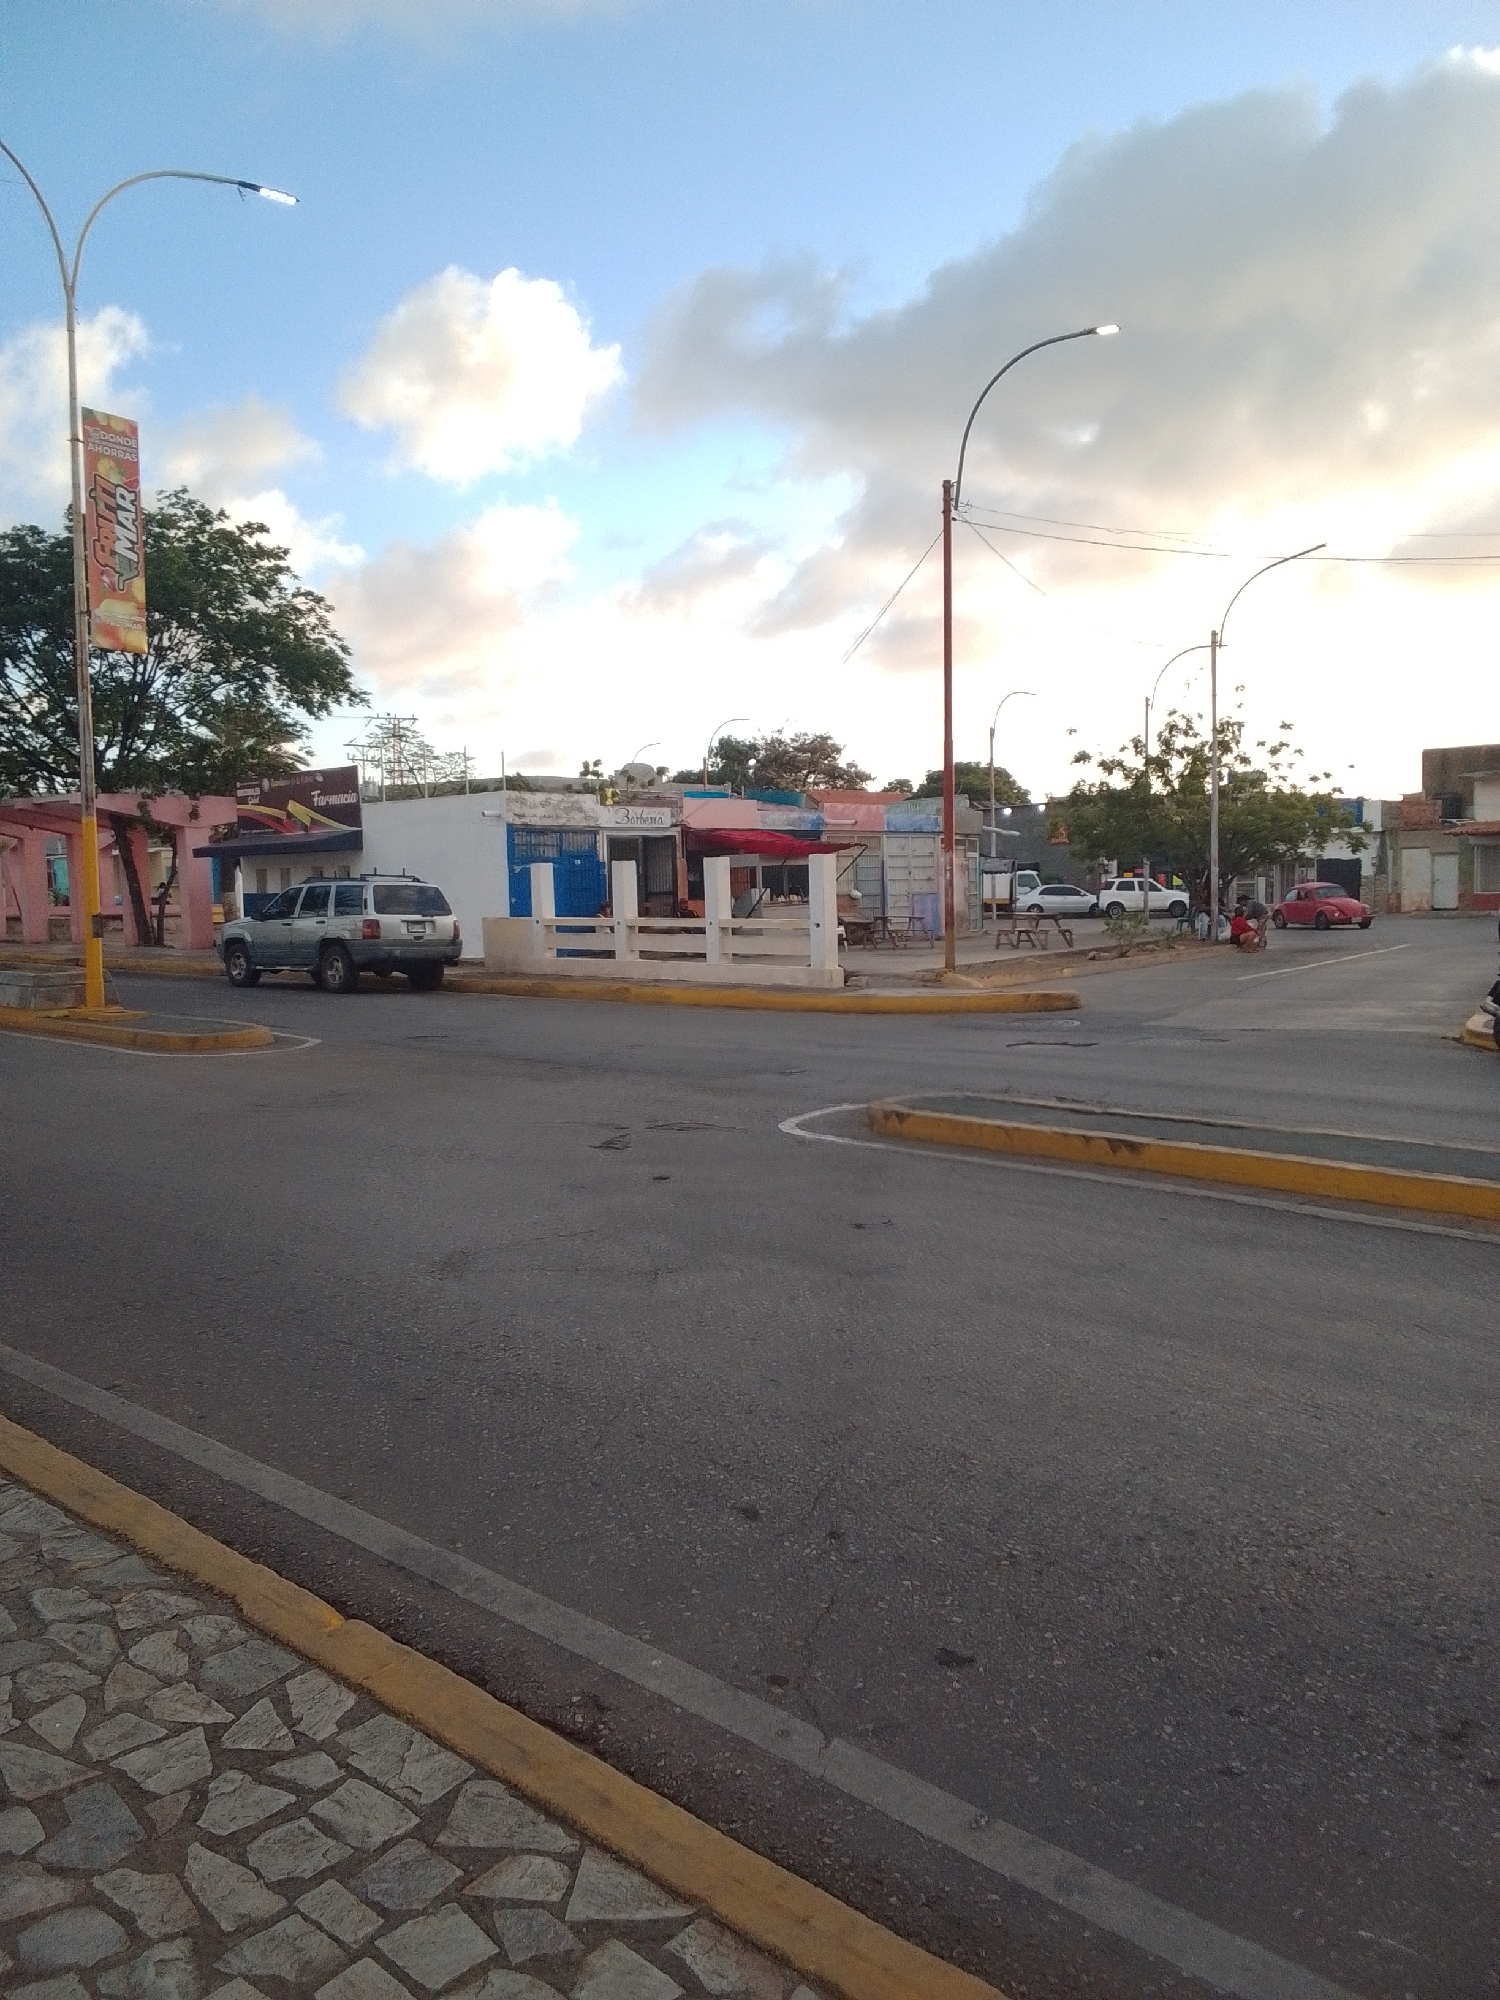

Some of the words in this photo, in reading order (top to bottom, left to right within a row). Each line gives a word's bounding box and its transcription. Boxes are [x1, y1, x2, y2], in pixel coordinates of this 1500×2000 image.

[87, 442, 138, 462] AHORRAS
[115, 486, 138, 562] MAR
[311, 789, 358, 807] Farmacia
